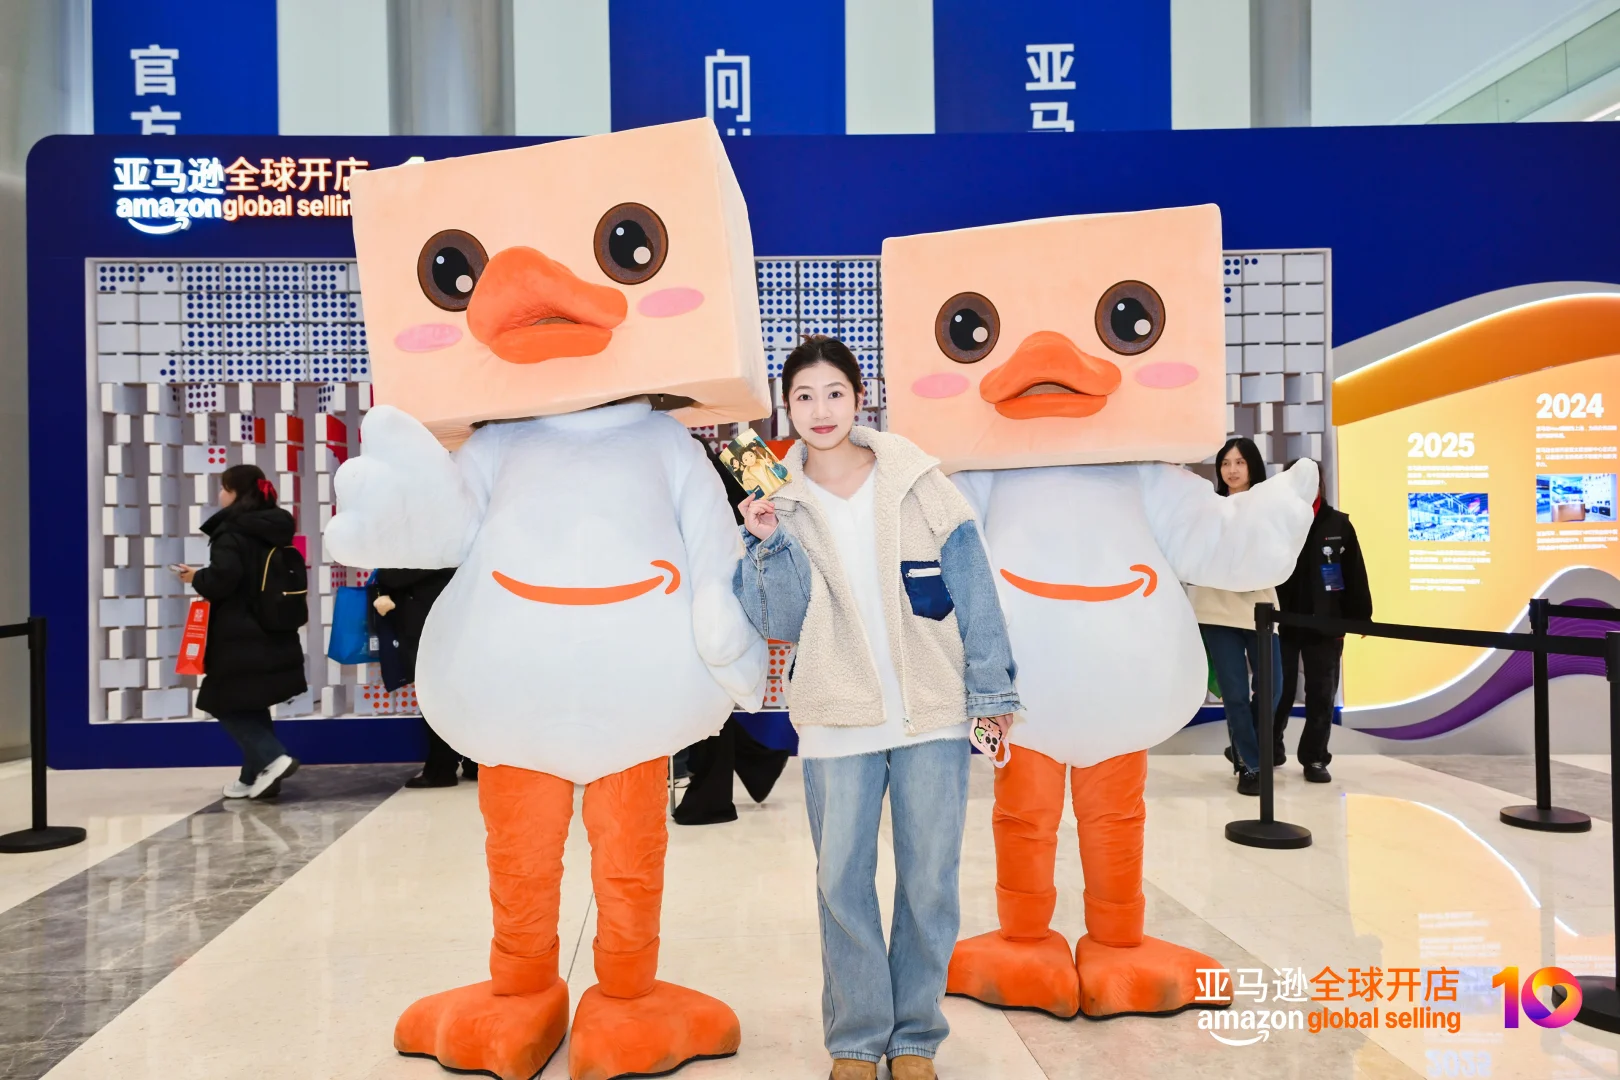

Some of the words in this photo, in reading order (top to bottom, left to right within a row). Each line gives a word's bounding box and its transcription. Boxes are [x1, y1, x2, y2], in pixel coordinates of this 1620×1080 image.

[130, 44, 181, 135] 官方
[705, 49, 751, 136] 向
[1025, 43, 1076, 132] 亚马
[116, 196, 222, 219] amazon
[223, 194, 292, 222] global
[297, 193, 353, 217] sellin
[1536, 392, 1604, 418] 2024
[1407, 432, 1475, 458] 2025
